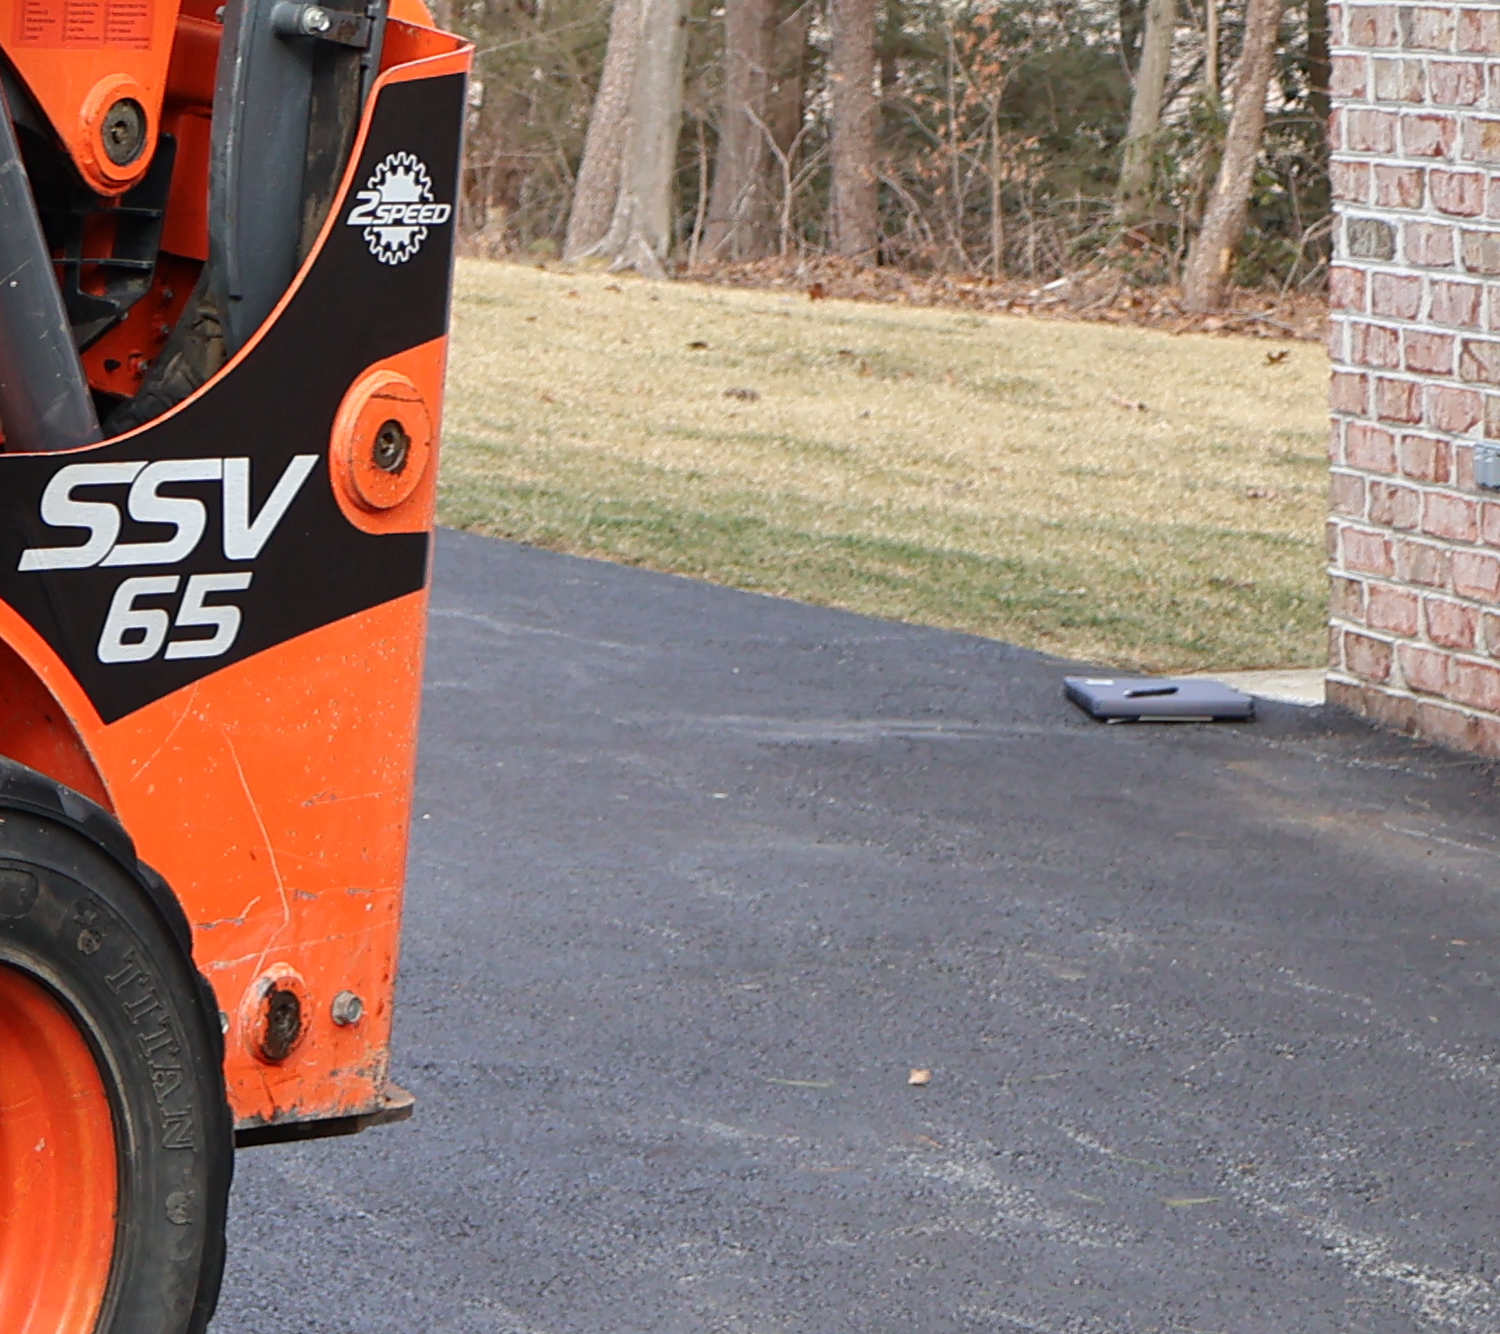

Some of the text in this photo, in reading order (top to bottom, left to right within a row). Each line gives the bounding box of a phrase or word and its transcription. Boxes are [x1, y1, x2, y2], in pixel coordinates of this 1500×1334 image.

[17, 454, 319, 572] SSV
[96, 571, 253, 664] 65
[103, 945, 197, 1151] TITAN
